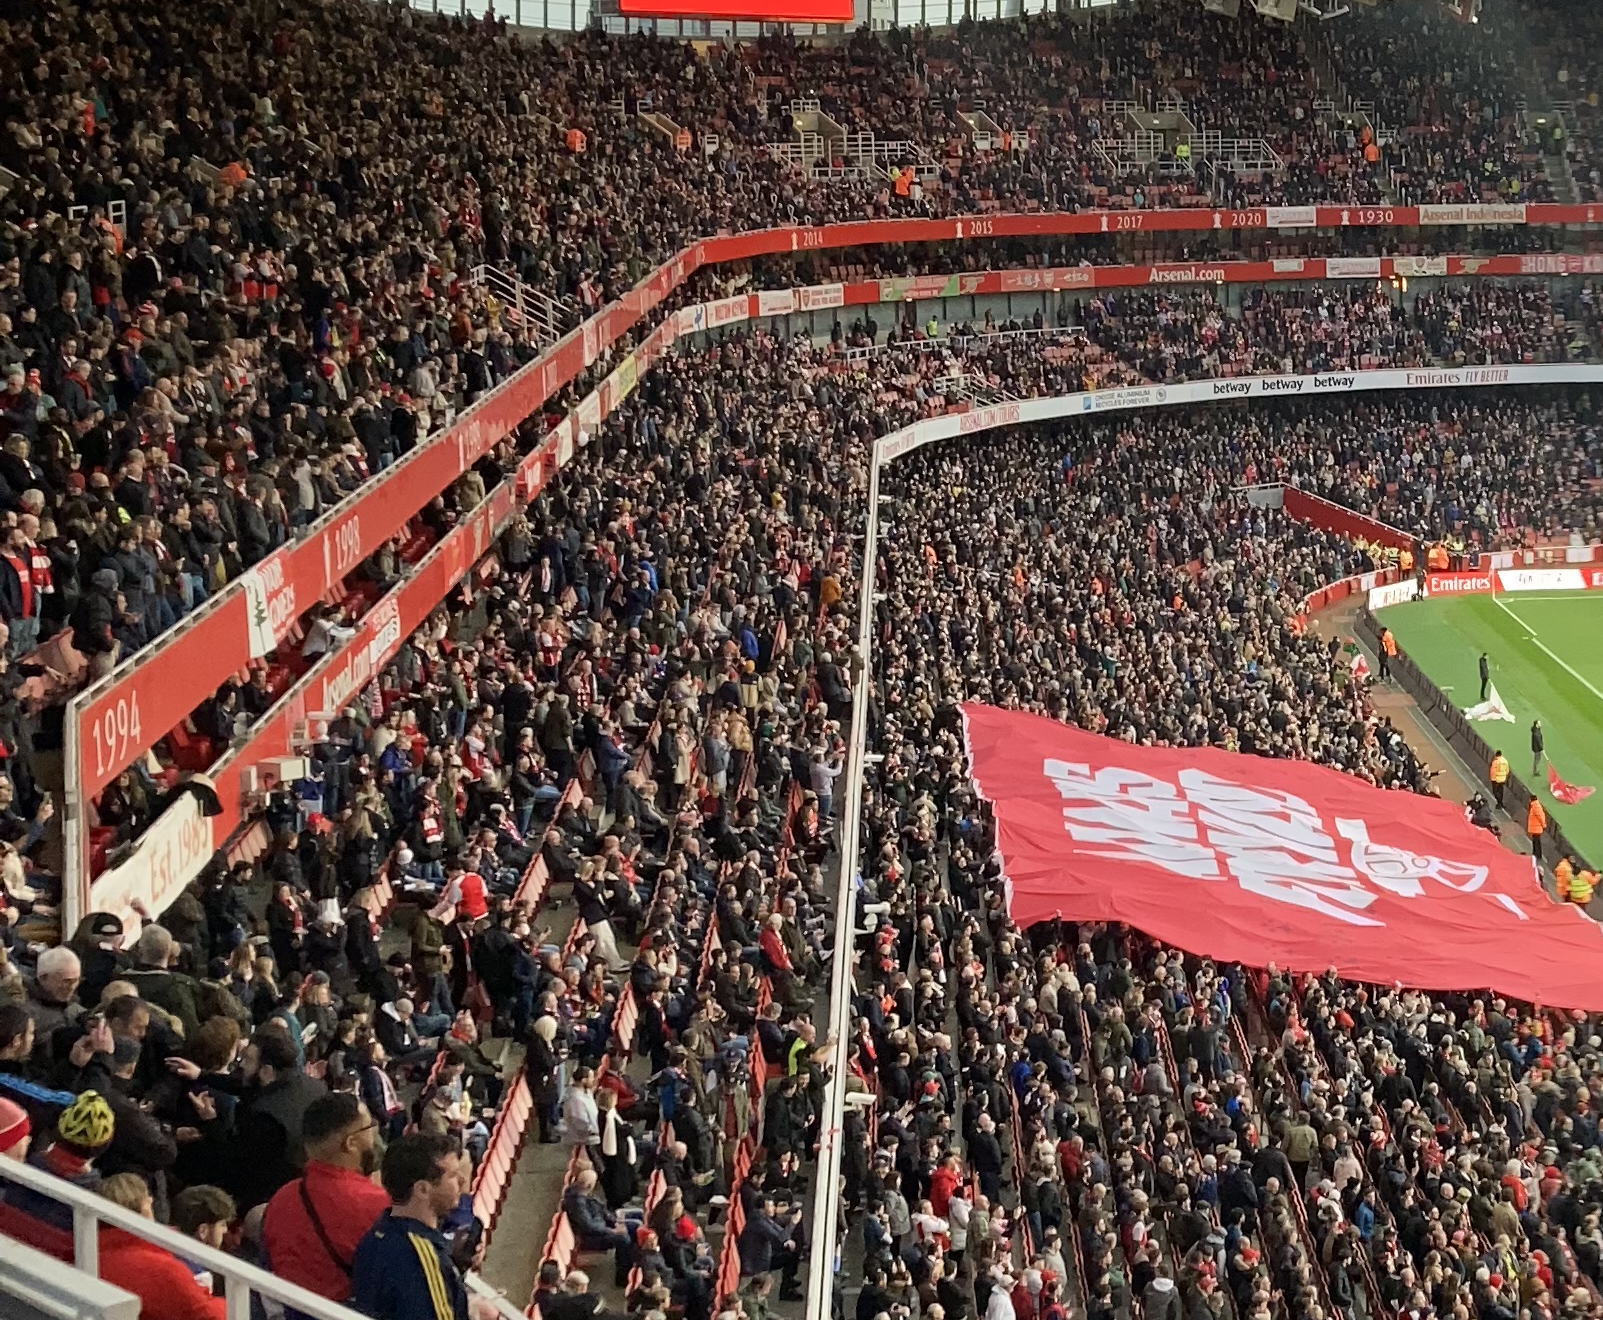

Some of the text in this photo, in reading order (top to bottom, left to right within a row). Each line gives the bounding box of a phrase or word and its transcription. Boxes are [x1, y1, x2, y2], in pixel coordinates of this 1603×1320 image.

[1117, 215, 1143, 229] 2017
[1232, 213, 1261, 226] 2020
[1358, 210, 1393, 223] 1930
[1422, 207, 1464, 222] Arsenal
[970, 220, 993, 235] 2015
[803, 231, 823, 246] 2014
[1528, 256, 1566, 272] HONG
[1149, 266, 1225, 283] Arsenal.com
[1314, 375, 1355, 389] betway
[1406, 369, 1509, 385] Emirates FLY BETTER
[1213, 381, 1251, 395] betway
[1262, 379, 1304, 392] betway
[335, 514, 361, 570] 1998
[1431, 576, 1491, 593] Emirates
[93, 689, 141, 777] 1994
